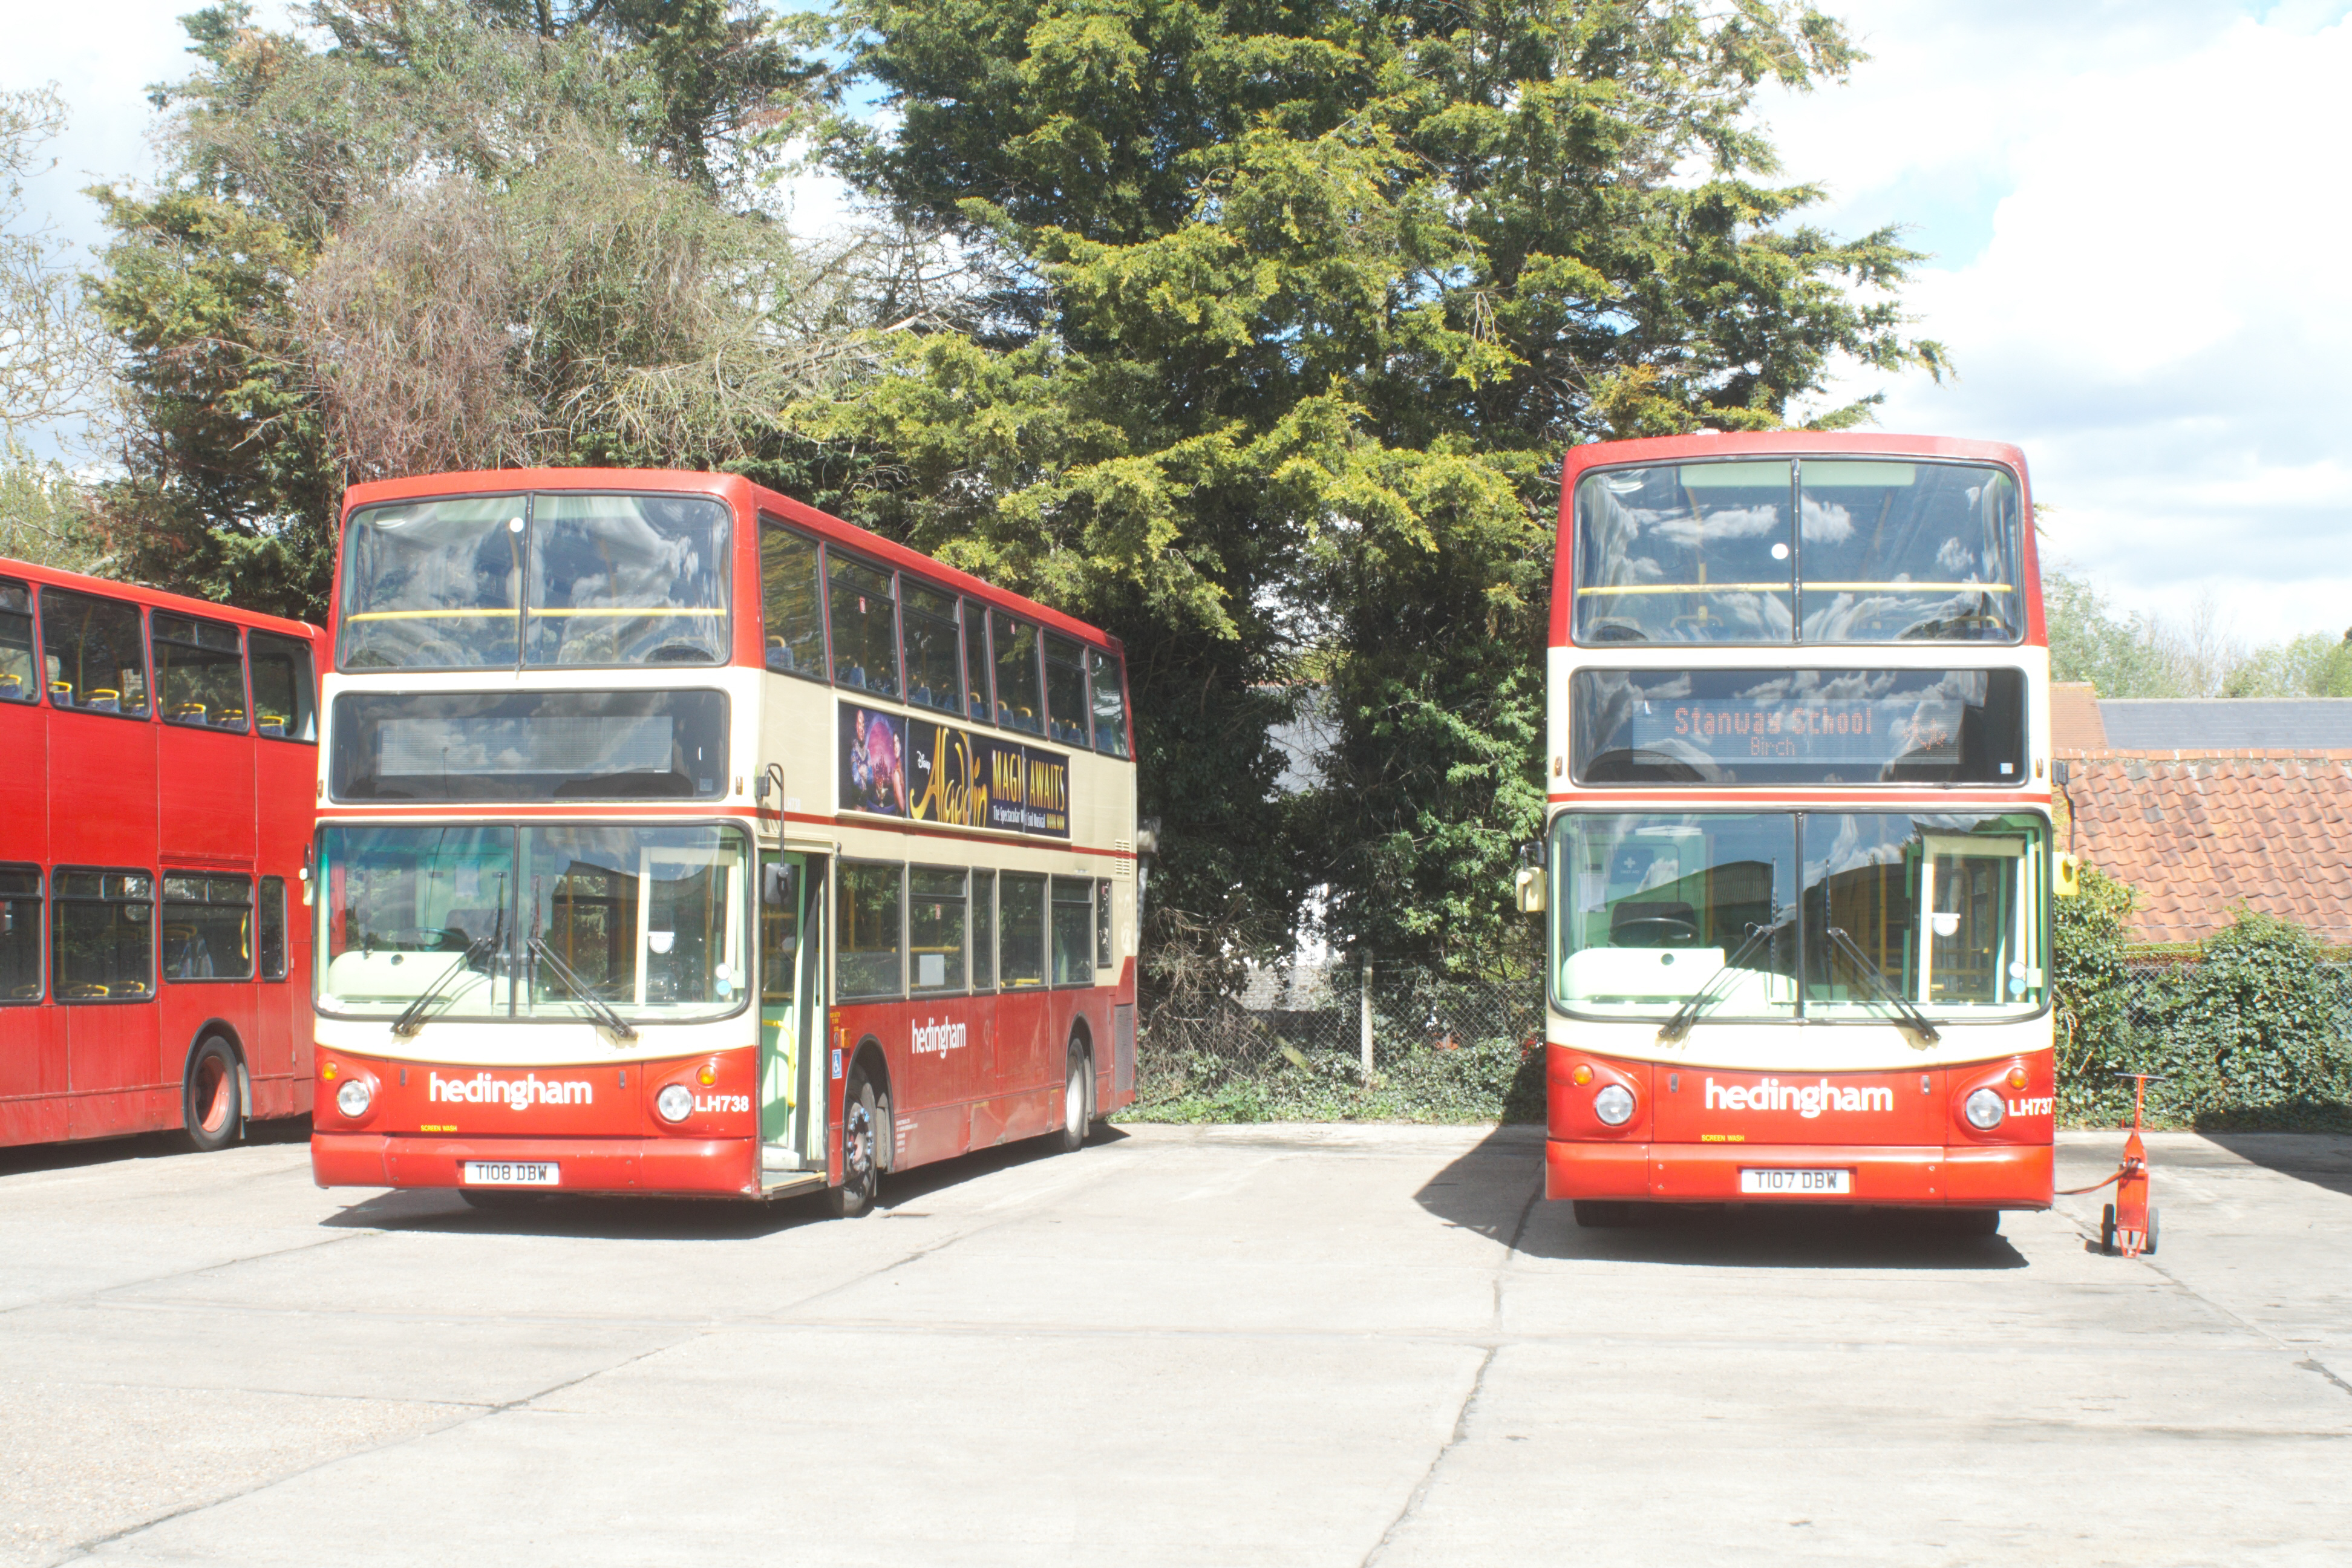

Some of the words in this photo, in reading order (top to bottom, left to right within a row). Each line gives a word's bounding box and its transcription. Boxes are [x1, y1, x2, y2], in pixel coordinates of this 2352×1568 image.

[1675, 707, 1781, 734] Stanway
[1792, 707, 1871, 734] School
[1751, 736, 1795, 756] Birch
[993, 750, 1027, 805] MAGI
[1030, 760, 1065, 812] AWAITS
[1000, 806, 1020, 825] Spectacular
[912, 1015, 966, 1059] hedingham
[430, 1071, 592, 1111] hedingham
[1705, 1077, 1893, 1119] hedingham
[695, 1096, 750, 1112] LH738
[2009, 1097, 2053, 1117] LH737
[475, 1165, 511, 1180] T108
[516, 1165, 547, 1181] DBW
[1755, 1172, 1795, 1189] T107
[1802, 1172, 1837, 1189] DBW
